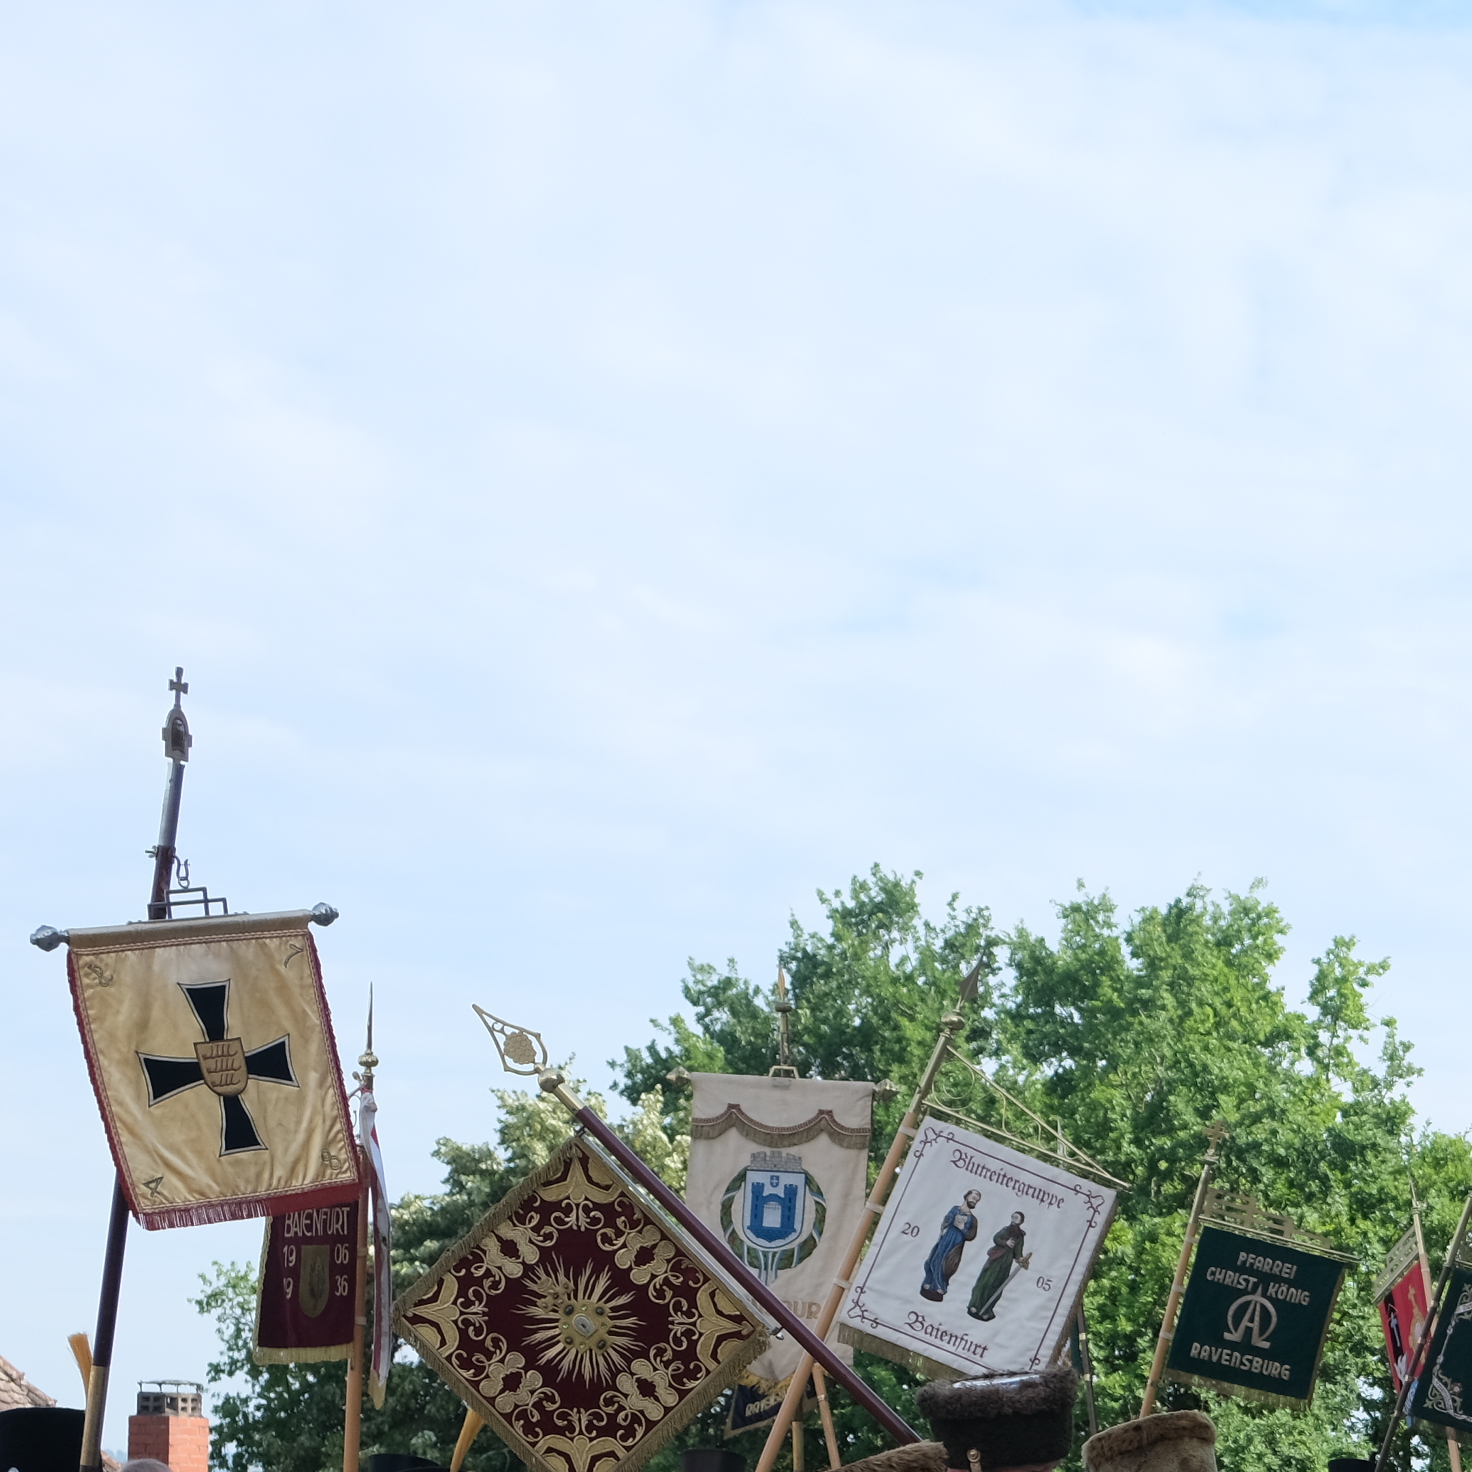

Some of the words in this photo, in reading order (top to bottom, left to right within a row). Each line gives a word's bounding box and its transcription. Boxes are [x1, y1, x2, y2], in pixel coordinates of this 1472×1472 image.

[142, 1175, 164, 1198] 4
[321, 1150, 342, 1171] 8
[950, 1148, 1065, 1210] Blutreitergruppe
[284, 1207, 351, 1238] BAIENFURT
[282, 1245, 296, 1268] 19
[334, 1243, 350, 1265] 06
[900, 1221, 921, 1238] 20
[1035, 1275, 1053, 1292] 05
[1236, 1251, 1298, 1280] PFARREI
[335, 1274, 349, 1297] 36
[1206, 1266, 1258, 1292] CHRIST
[1266, 1281, 1311, 1306] KÖNIG
[904, 1310, 989, 1360] Baienfurt
[1189, 1341, 1292, 1381] RAVENSBURG
